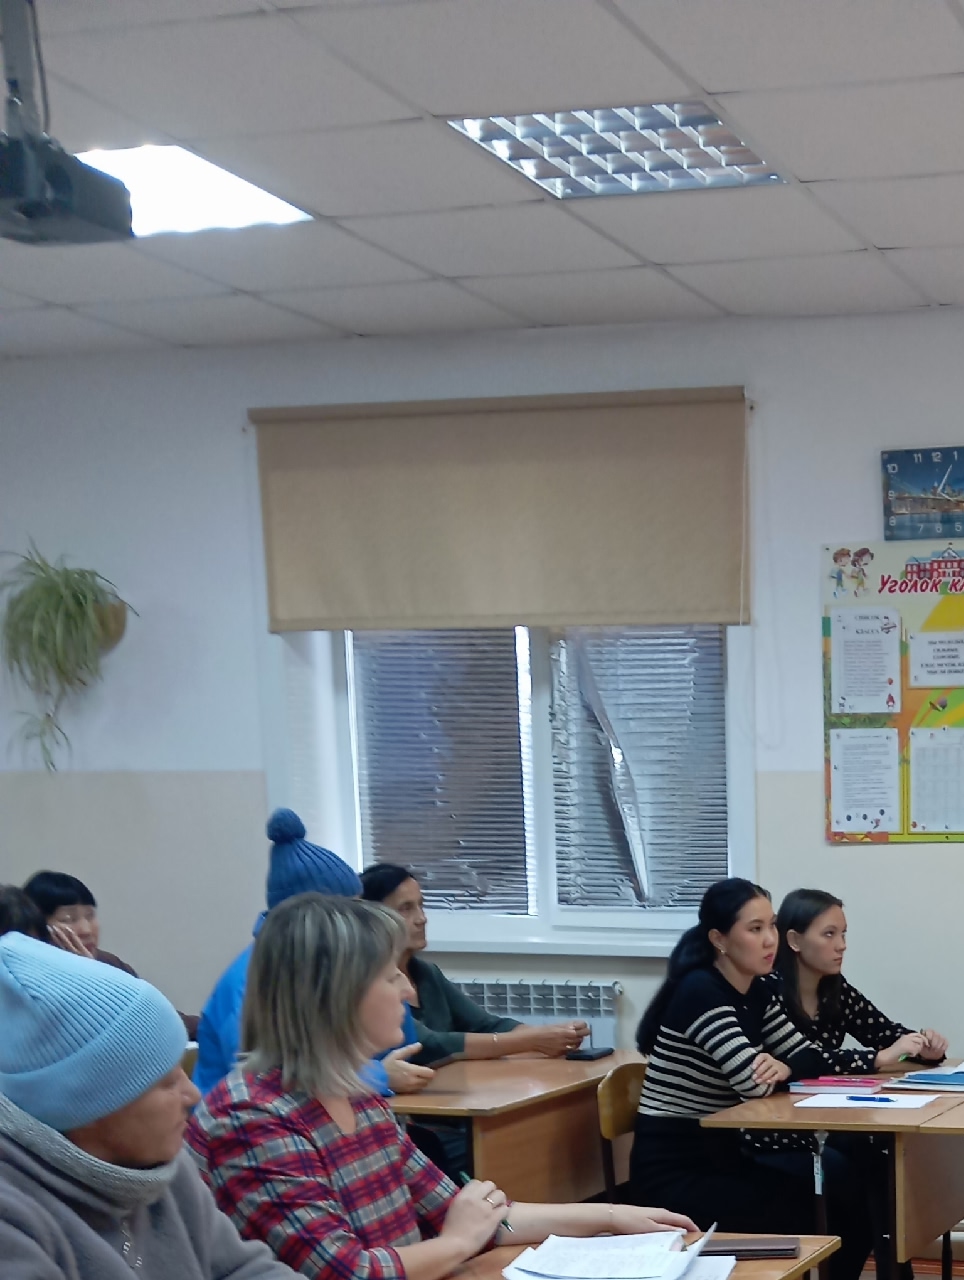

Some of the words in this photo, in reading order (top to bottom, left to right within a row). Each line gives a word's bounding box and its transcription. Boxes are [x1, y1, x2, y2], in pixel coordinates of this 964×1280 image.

[913, 453, 922, 463] 11
[931, 452, 942, 462] 12
[953, 451, 958, 461] 1
[887, 463, 898, 473] 10
[955, 522, 961, 531] 5
[878, 574, 942, 594] Уголок
